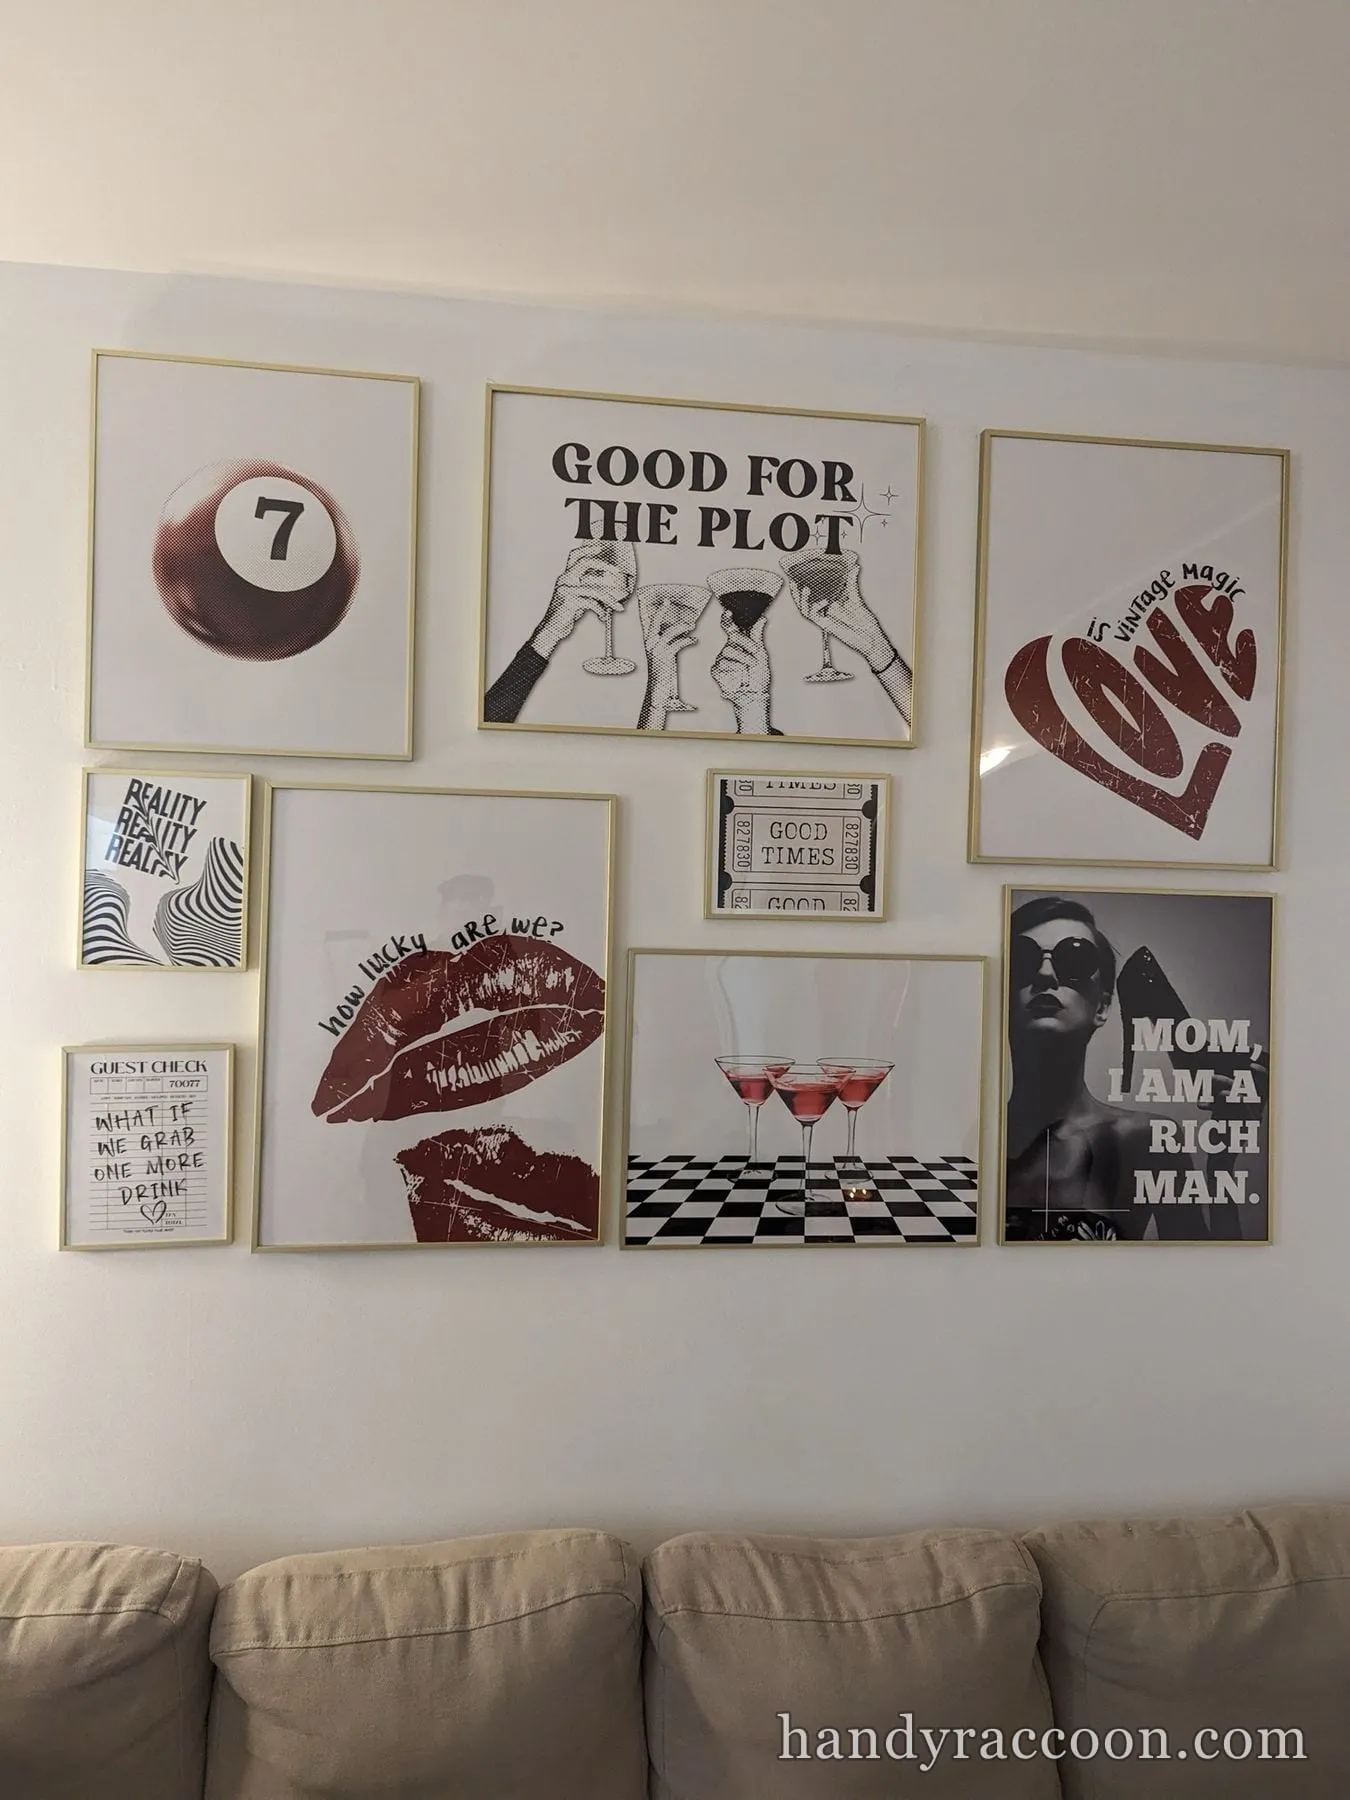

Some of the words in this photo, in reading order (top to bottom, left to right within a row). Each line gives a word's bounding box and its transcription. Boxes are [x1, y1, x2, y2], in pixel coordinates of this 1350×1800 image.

[552, 442, 728, 493] GOOD
[746, 455, 858, 503] FOR
[254, 496, 305, 561] 7
[564, 497, 678, 545] THE
[697, 505, 854, 556] PLOT
[1004, 585, 1257, 841] LOVE
[123, 778, 208, 826] REALITY
[113, 806, 198, 854] REALITY
[736, 820, 751, 868] 827830
[770, 821, 828, 841] GOOD
[844, 823, 860, 870] 827830
[104, 833, 189, 885] REALITY
[761, 846, 835, 866] TIMES
[318, 984, 366, 1037] how
[358, 933, 428, 982] lucky
[1131, 1017, 1263, 1062] MOM,
[90, 1061, 148, 1074] GUEST
[151, 1060, 207, 1074] CHECK
[169, 1080, 201, 1088] 70077
[1107, 1068, 1124, 1102] I
[1135, 1069, 1215, 1103] AM
[1225, 1069, 1262, 1103] A
[95, 1105, 159, 1132] WHAT
[170, 1102, 193, 1122] IF
[1149, 1119, 1260, 1154] RICH
[98, 1138, 127, 1157] WE
[141, 1127, 195, 1152] GRAB
[94, 1162, 132, 1181] ONE
[146, 1152, 203, 1176] MORE
[118, 1178, 188, 1206] DRINK
[1133, 1170, 1260, 1205] MAN.
